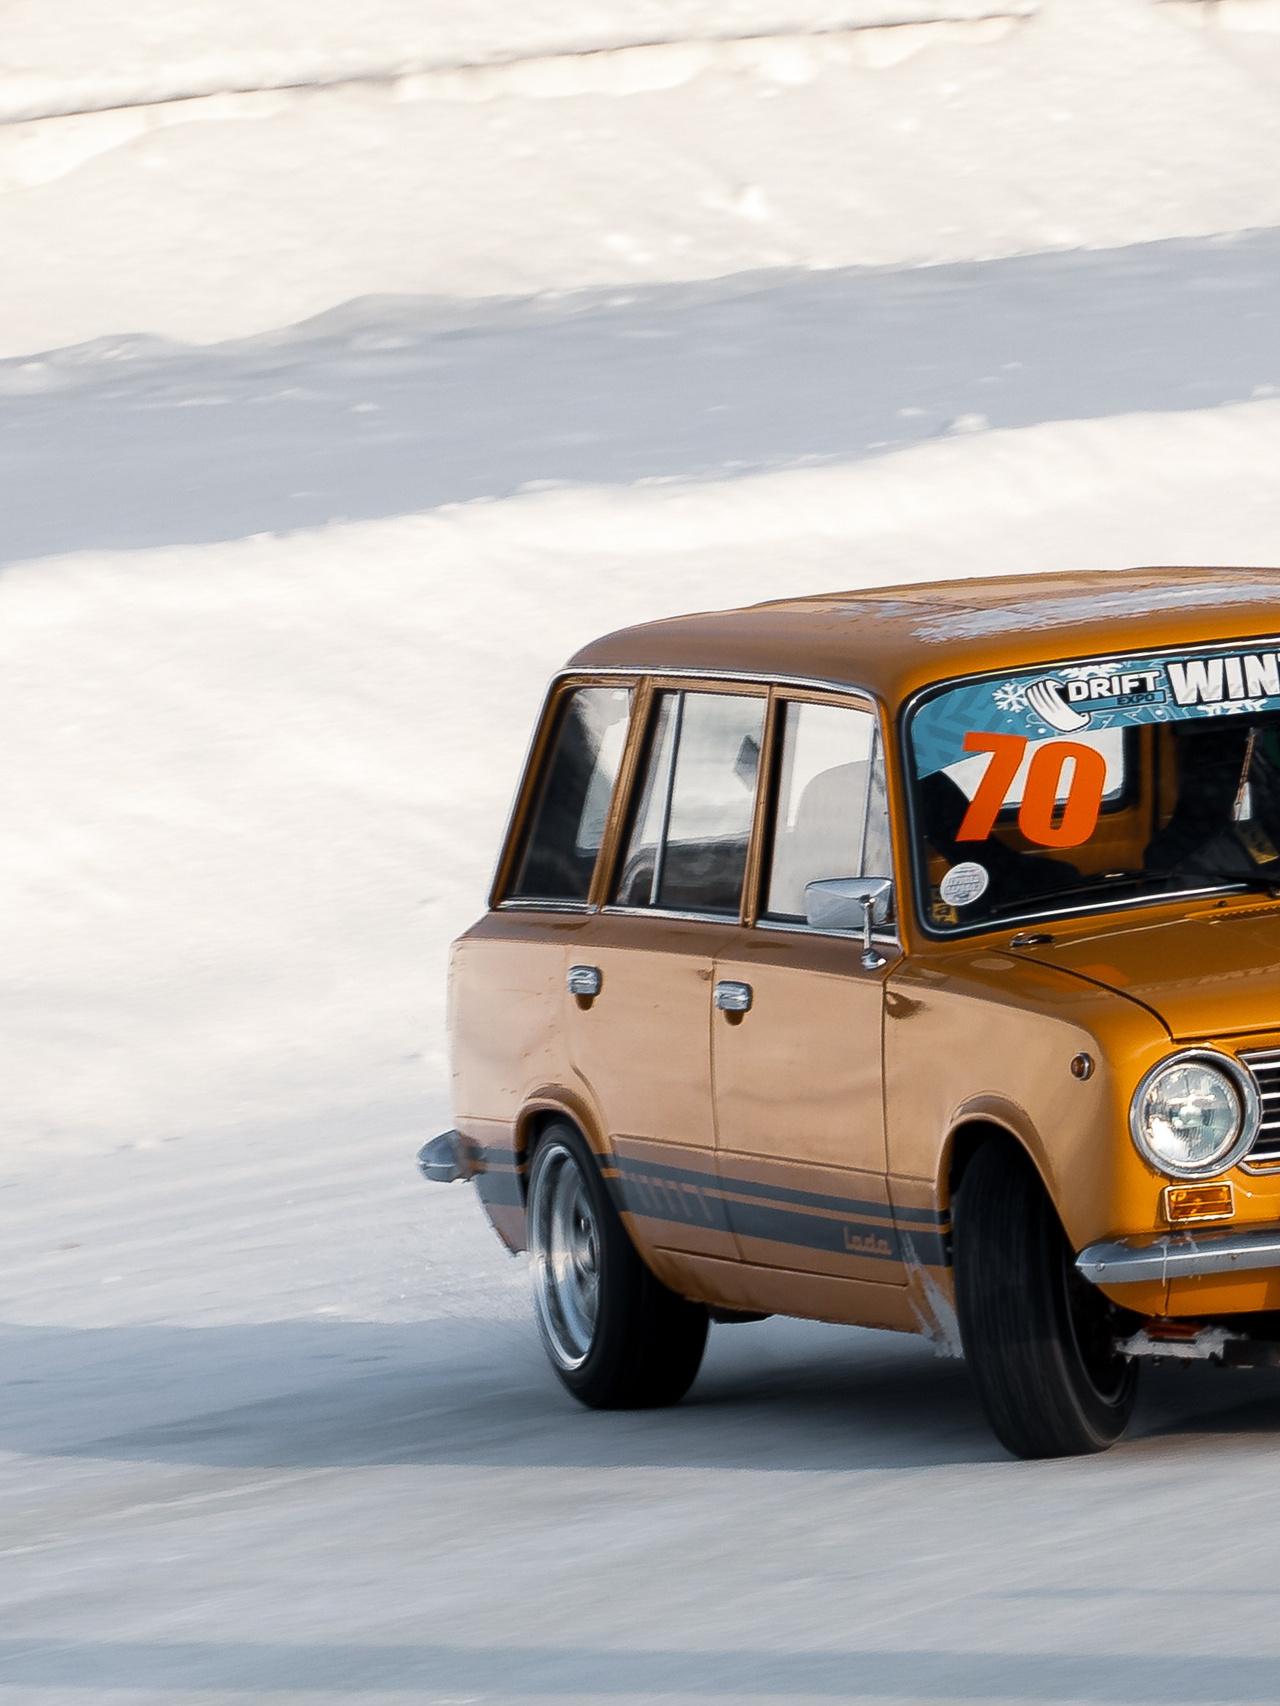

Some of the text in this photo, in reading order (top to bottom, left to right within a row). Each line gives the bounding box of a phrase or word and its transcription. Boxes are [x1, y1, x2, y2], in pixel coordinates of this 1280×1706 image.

[1067, 671, 1160, 702] DRIFT
[1116, 694, 1155, 706] EXPO
[955, 731, 1107, 848] 70
